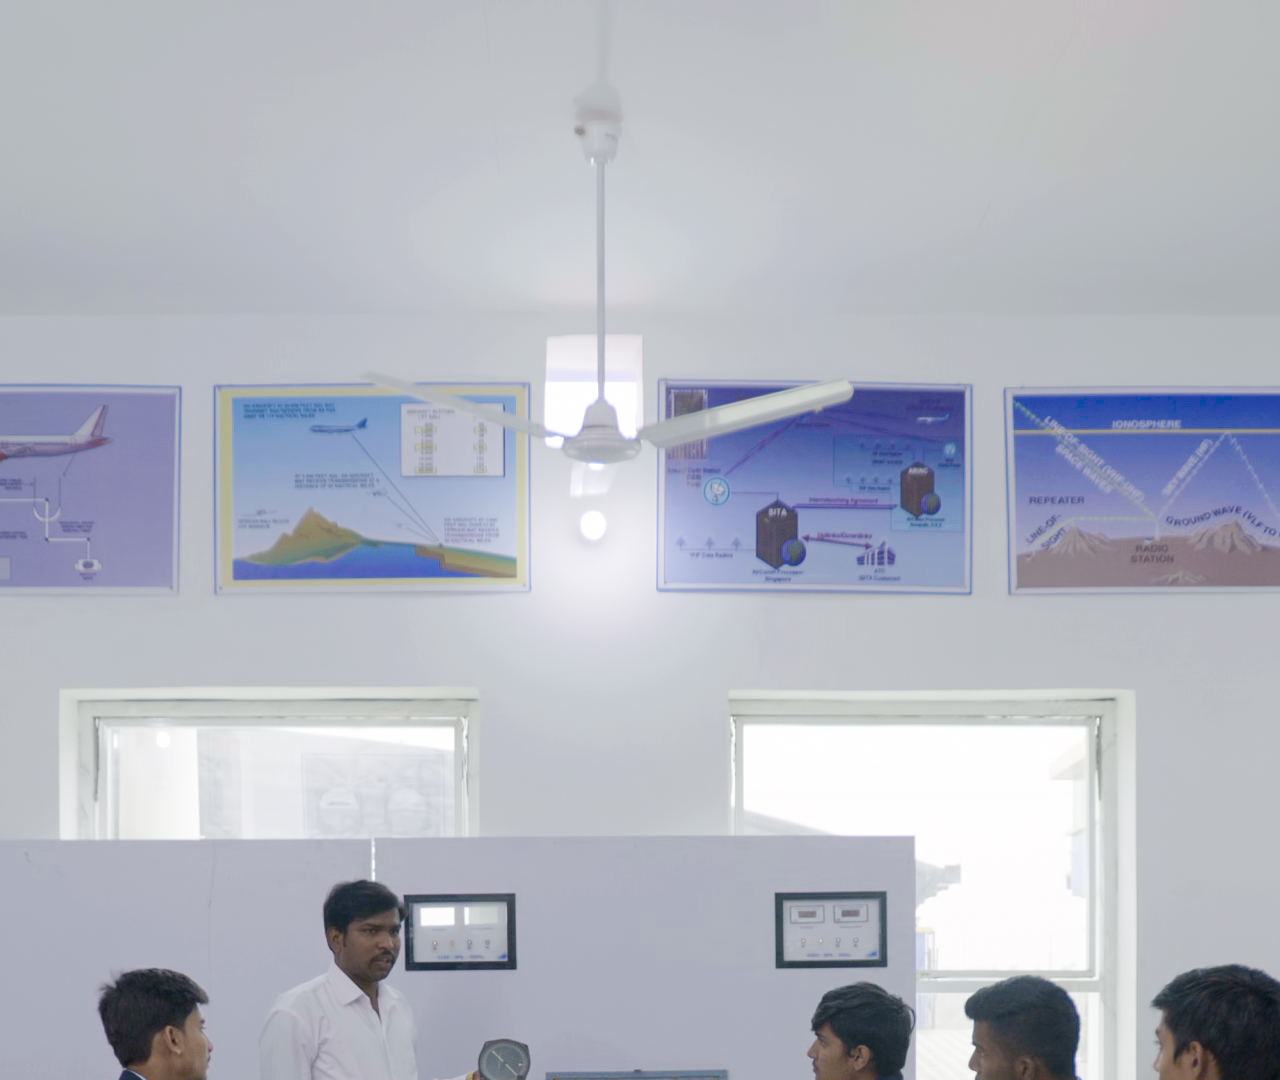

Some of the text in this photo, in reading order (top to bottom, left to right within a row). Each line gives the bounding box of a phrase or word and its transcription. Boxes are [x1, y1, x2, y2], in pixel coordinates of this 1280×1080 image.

[1112, 419, 1182, 429] IONOSPHERE
[1055, 444, 1113, 494] SPACE WAVES
[1028, 496, 1084, 505] REPEATER
[768, 507, 788, 517] SITA
[1165, 511, 1212, 527] GROUND
[1212, 504, 1243, 516] WAVE
[1039, 526, 1067, 550] SIGHT
[1134, 544, 1168, 553] RADIO
[1130, 554, 1174, 564] STATION
